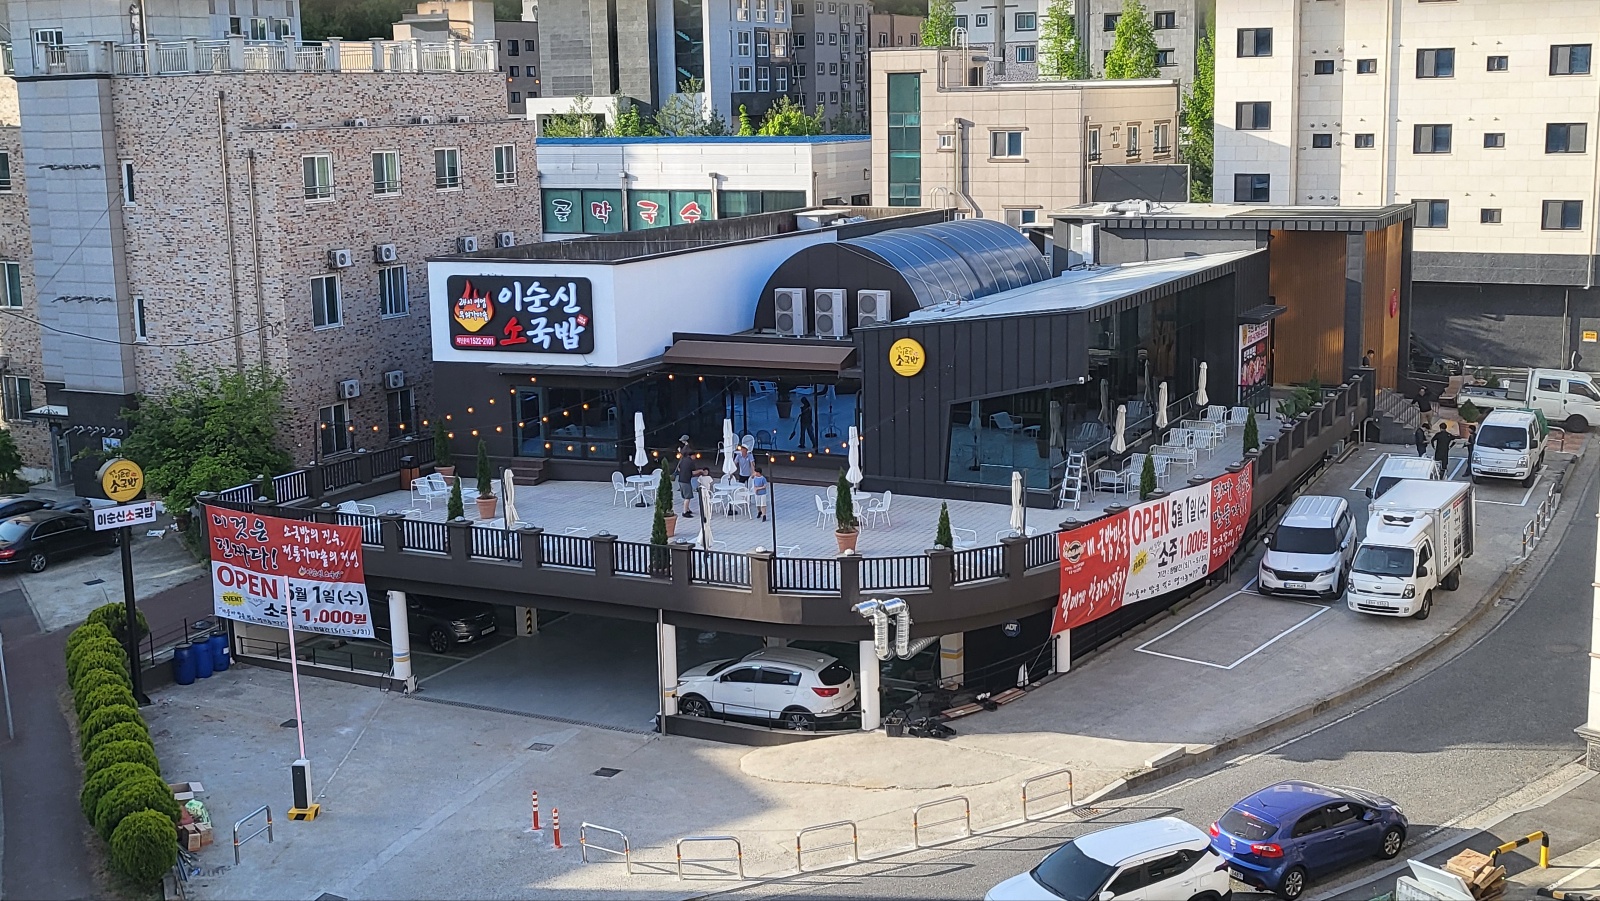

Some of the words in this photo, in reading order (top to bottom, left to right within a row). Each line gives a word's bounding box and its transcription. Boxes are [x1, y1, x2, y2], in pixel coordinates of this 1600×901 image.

[498, 281, 581, 313] 이순신
[500, 316, 585, 350] 소국밥
[97, 506, 153, 526] 이순신소국밥
[212, 514, 269, 542] 이것은
[1132, 500, 1170, 546] OPEN
[1171, 500, 1183, 529] 5월
[283, 525, 319, 544] 소국밥의
[1158, 537, 1178, 568] 소주
[1180, 529, 1208, 560] 1,000원
[214, 537, 278, 570] 진짜다!
[282, 544, 338, 567] 전통가마솥의
[340, 549, 359, 568] 정성
[1133, 555, 1147, 572] EVENT
[217, 565, 278, 600] OPEN
[222, 595, 243, 603] EVENT
[264, 603, 298, 618] 소주
[302, 609, 367, 625] 1,000원
[1005, 623, 1018, 631] ADT
